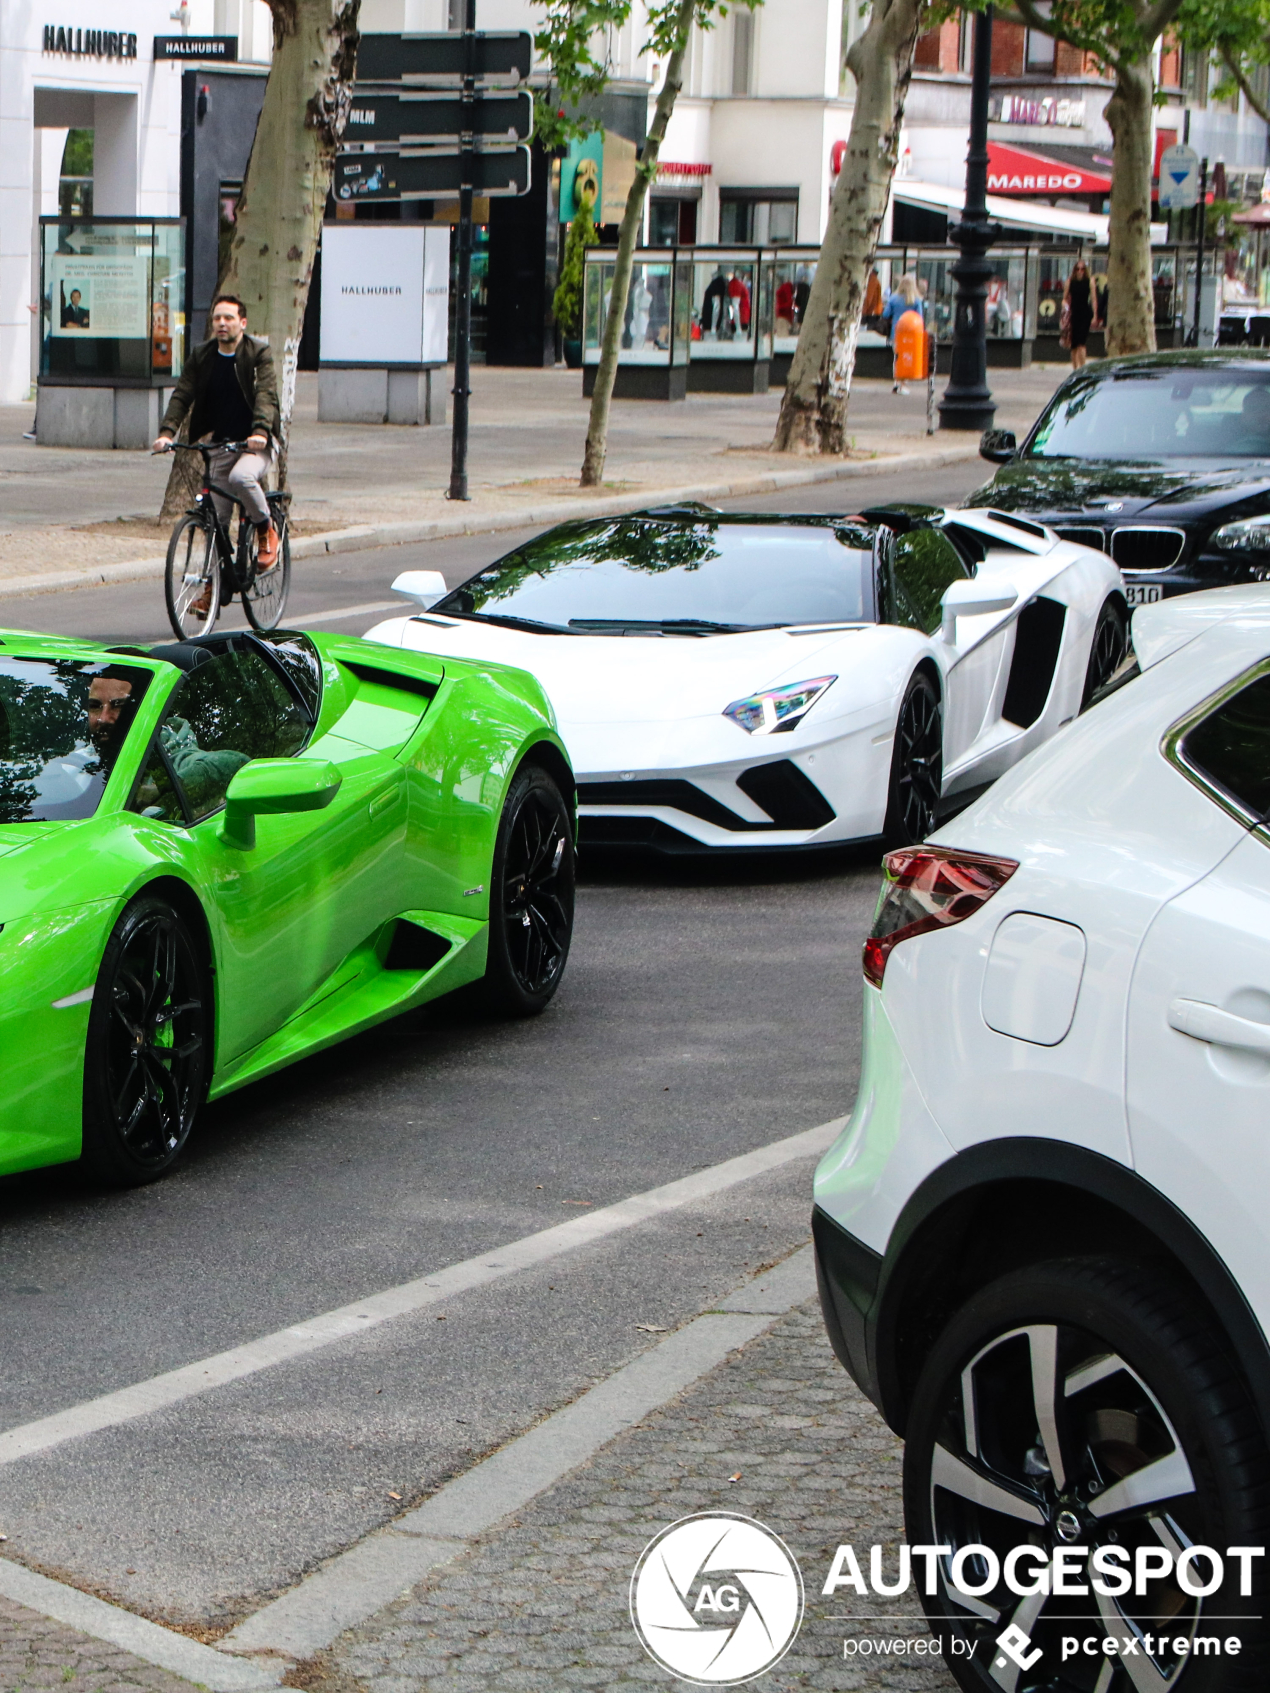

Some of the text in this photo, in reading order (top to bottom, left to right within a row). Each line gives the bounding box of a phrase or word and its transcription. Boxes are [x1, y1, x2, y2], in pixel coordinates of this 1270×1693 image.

[44, 25, 137, 58] HALLHUBER
[166, 42, 225, 54] HALLHUBER
[350, 109, 375, 125] MLM
[987, 173, 1082, 189] MAREDO
[341, 286, 402, 296] HALLHUBER
